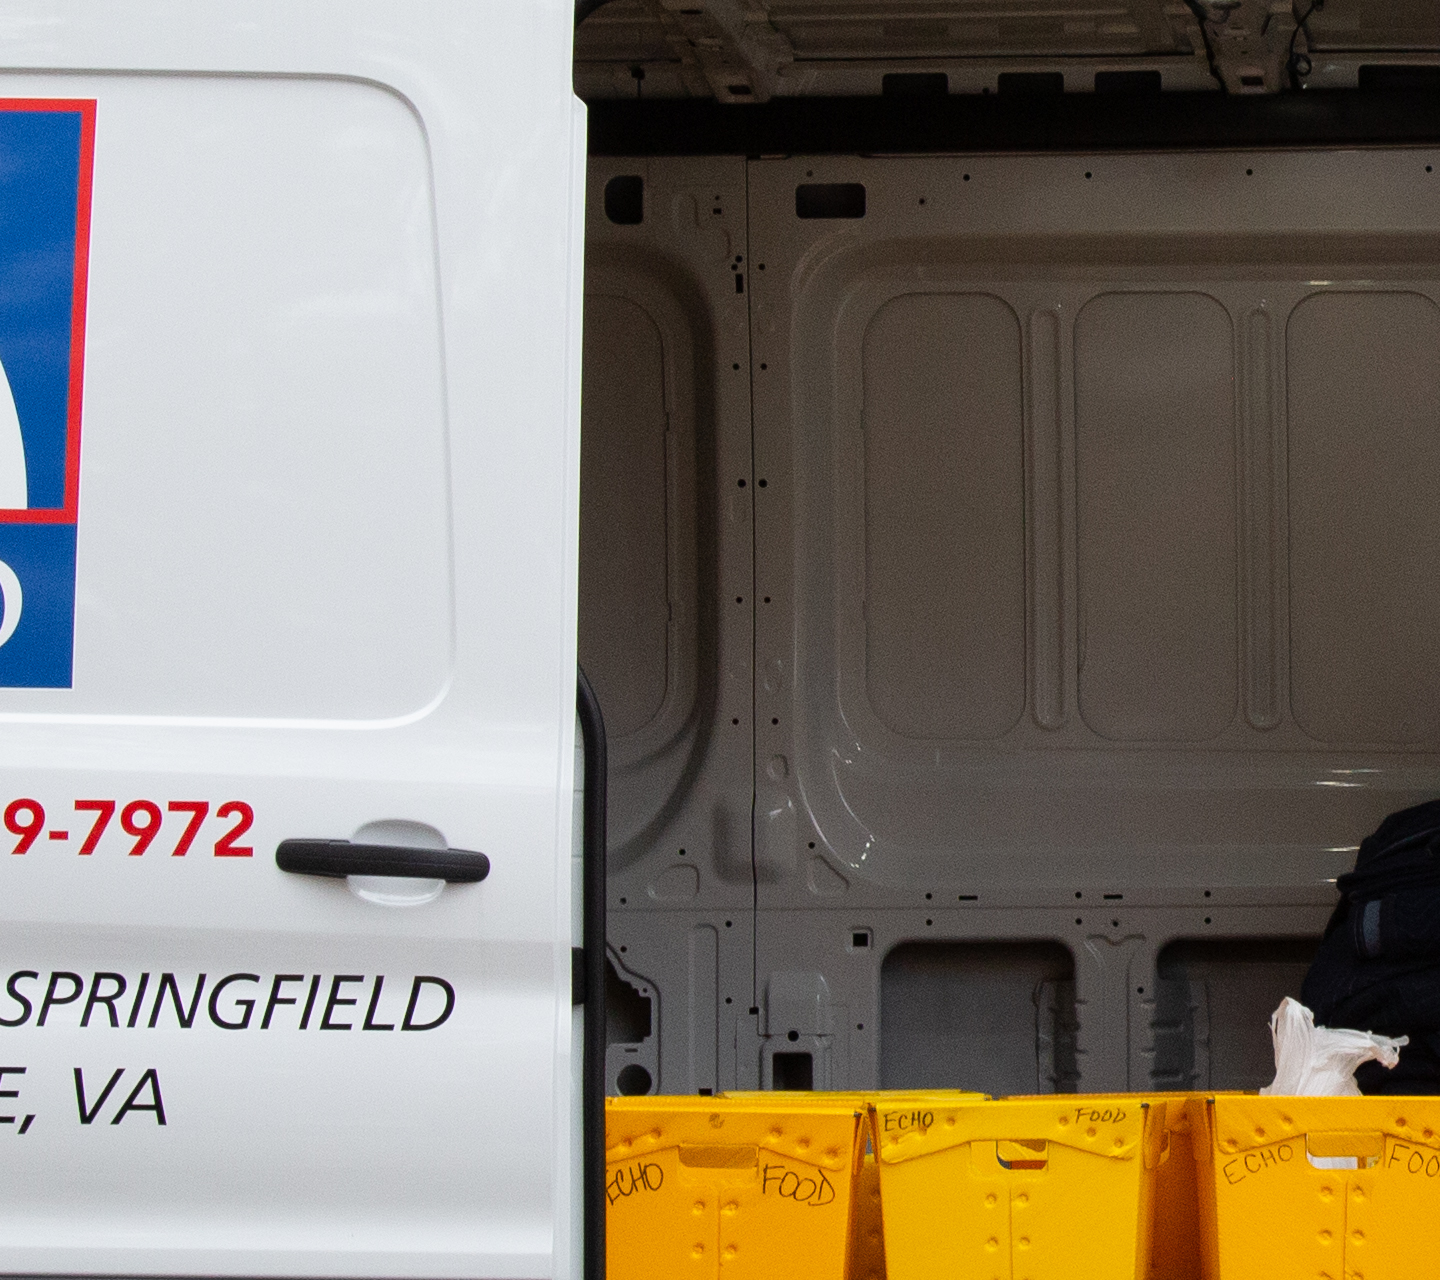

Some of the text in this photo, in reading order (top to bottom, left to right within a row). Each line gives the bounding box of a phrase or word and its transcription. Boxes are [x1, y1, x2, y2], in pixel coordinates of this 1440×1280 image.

[72, 1066, 168, 1127] VA
[883, 1107, 1126, 1131] ECHO FOOD
[605, 1162, 835, 1206] ECHO FOOD
[1222, 1144, 1294, 1185] ECHO
